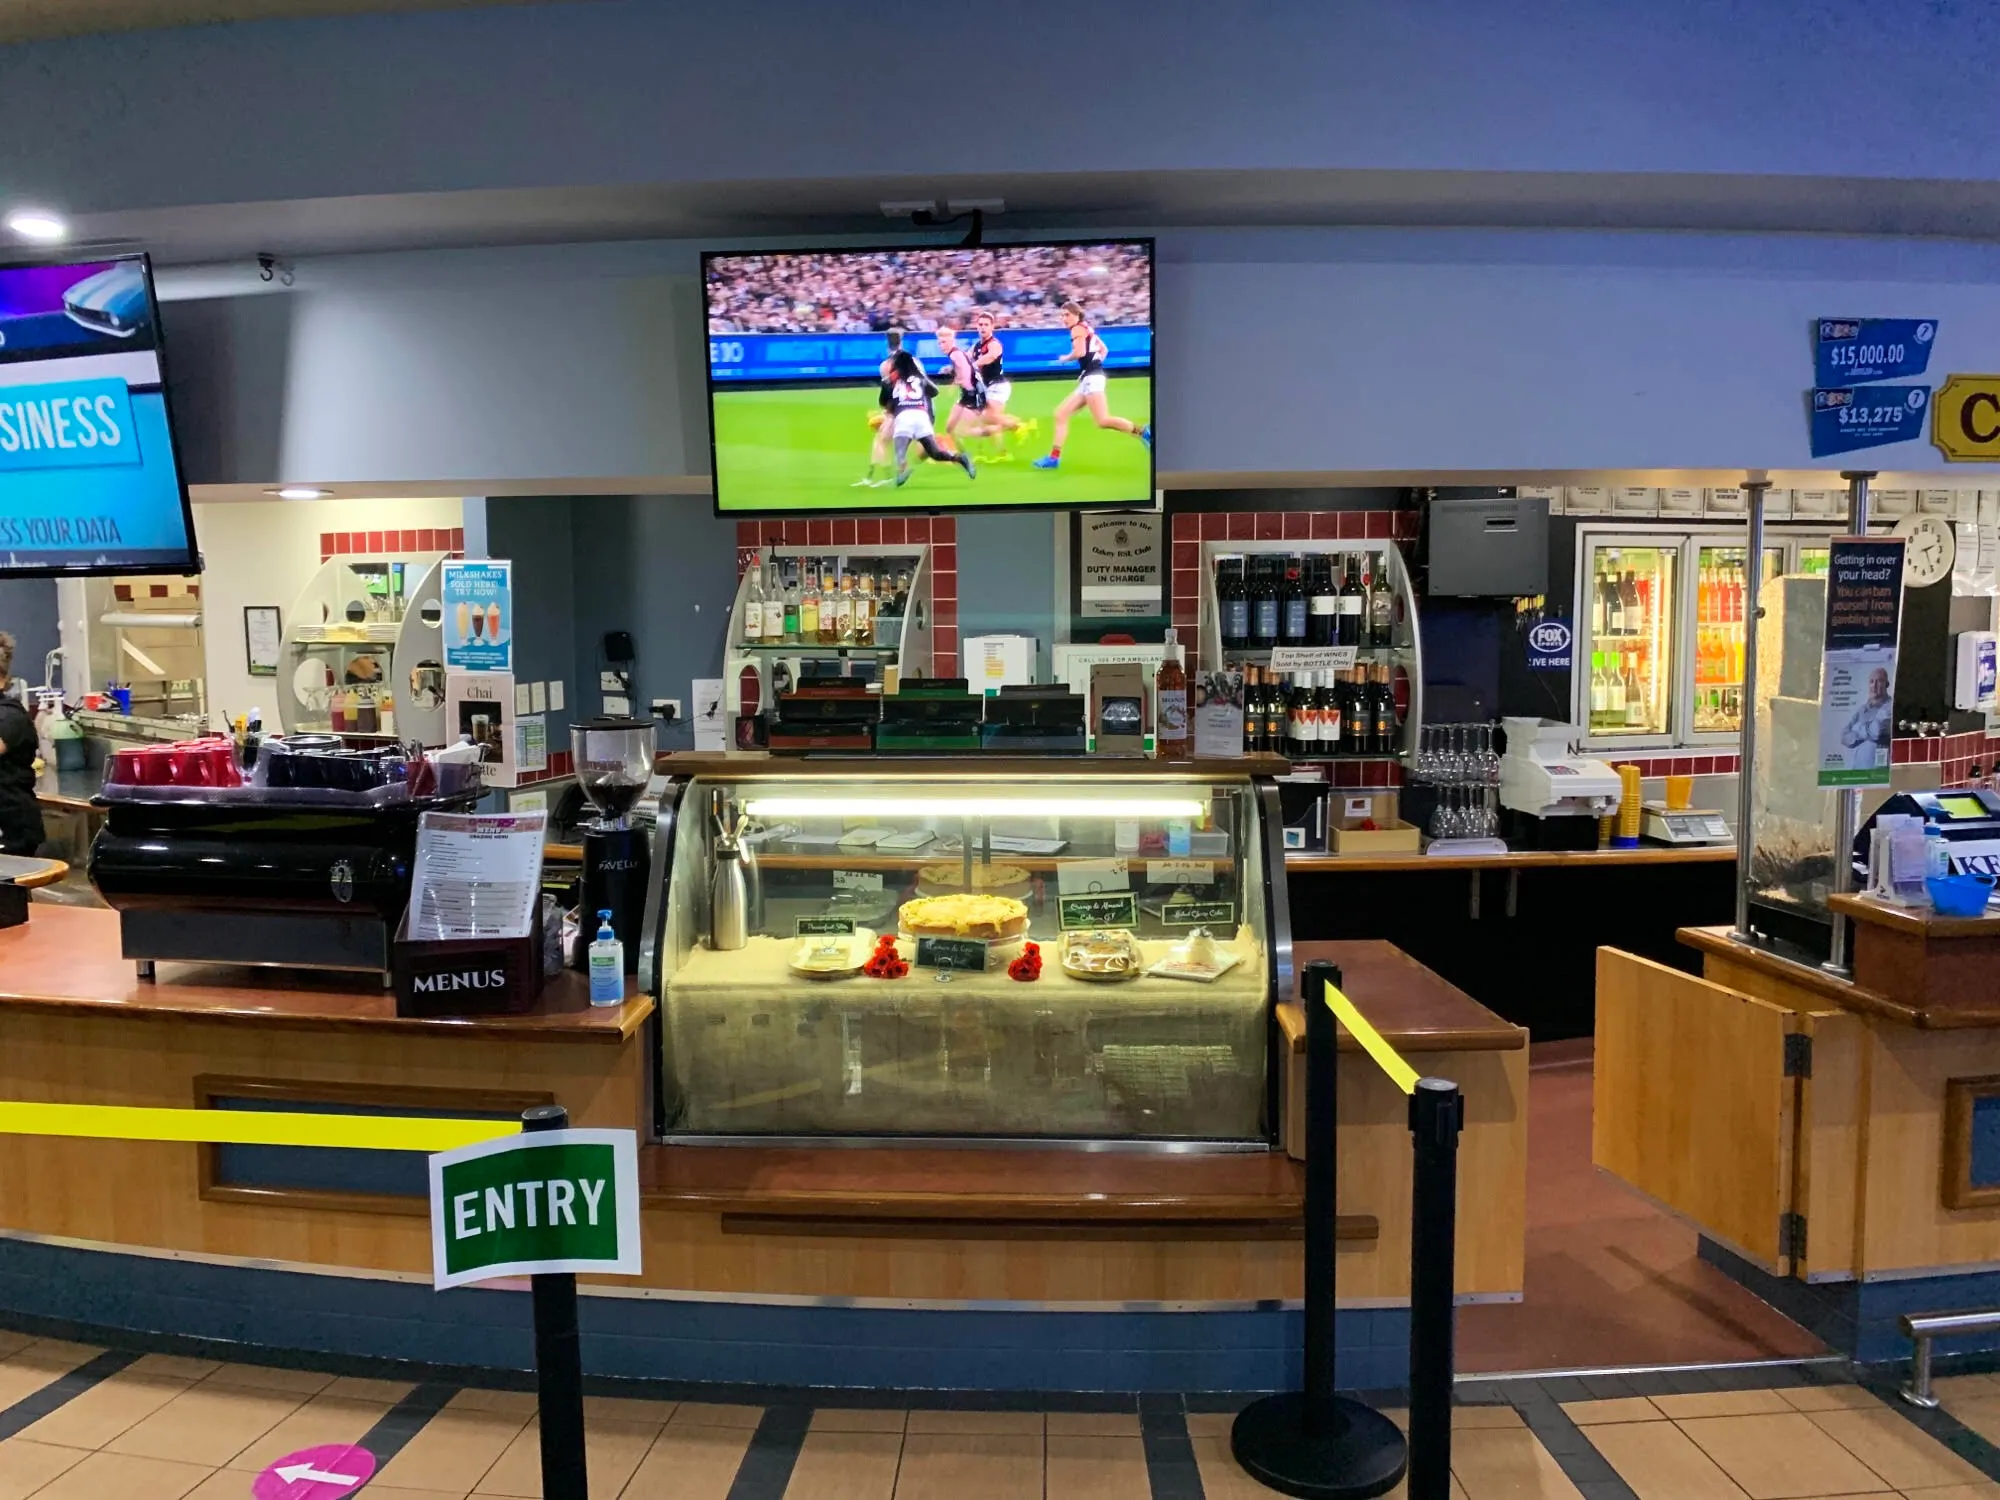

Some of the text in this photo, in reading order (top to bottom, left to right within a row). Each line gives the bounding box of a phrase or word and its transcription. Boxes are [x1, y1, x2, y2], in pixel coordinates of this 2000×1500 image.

[1831, 344, 1904, 367] $15,000.00
[1839, 406, 1903, 426] $13,275
[24, 517, 73, 544] YOUR
[76, 515, 123, 544] DATA
[1092, 520, 1127, 531] Welcome
[1140, 521, 1153, 531] the
[1834, 554, 1897, 567] Getting in over
[449, 570, 503, 579] MILKSHAKES
[1087, 565, 1156, 573] DUTY MANAGER
[1838, 568, 1891, 583] your head?
[450, 580, 472, 588] SOLD
[455, 588, 497, 596] TRY NOW!
[1836, 586, 1853, 597] You
[1832, 600, 1893, 612] yourself from
[1831, 613, 1869, 627] gambling
[1537, 628, 1562, 642] FOX
[1549, 657, 1570, 666] HERE
[466, 686, 493, 699] Chai
[413, 969, 505, 993] MENUS
[454, 1178, 606, 1240] ENTRY
